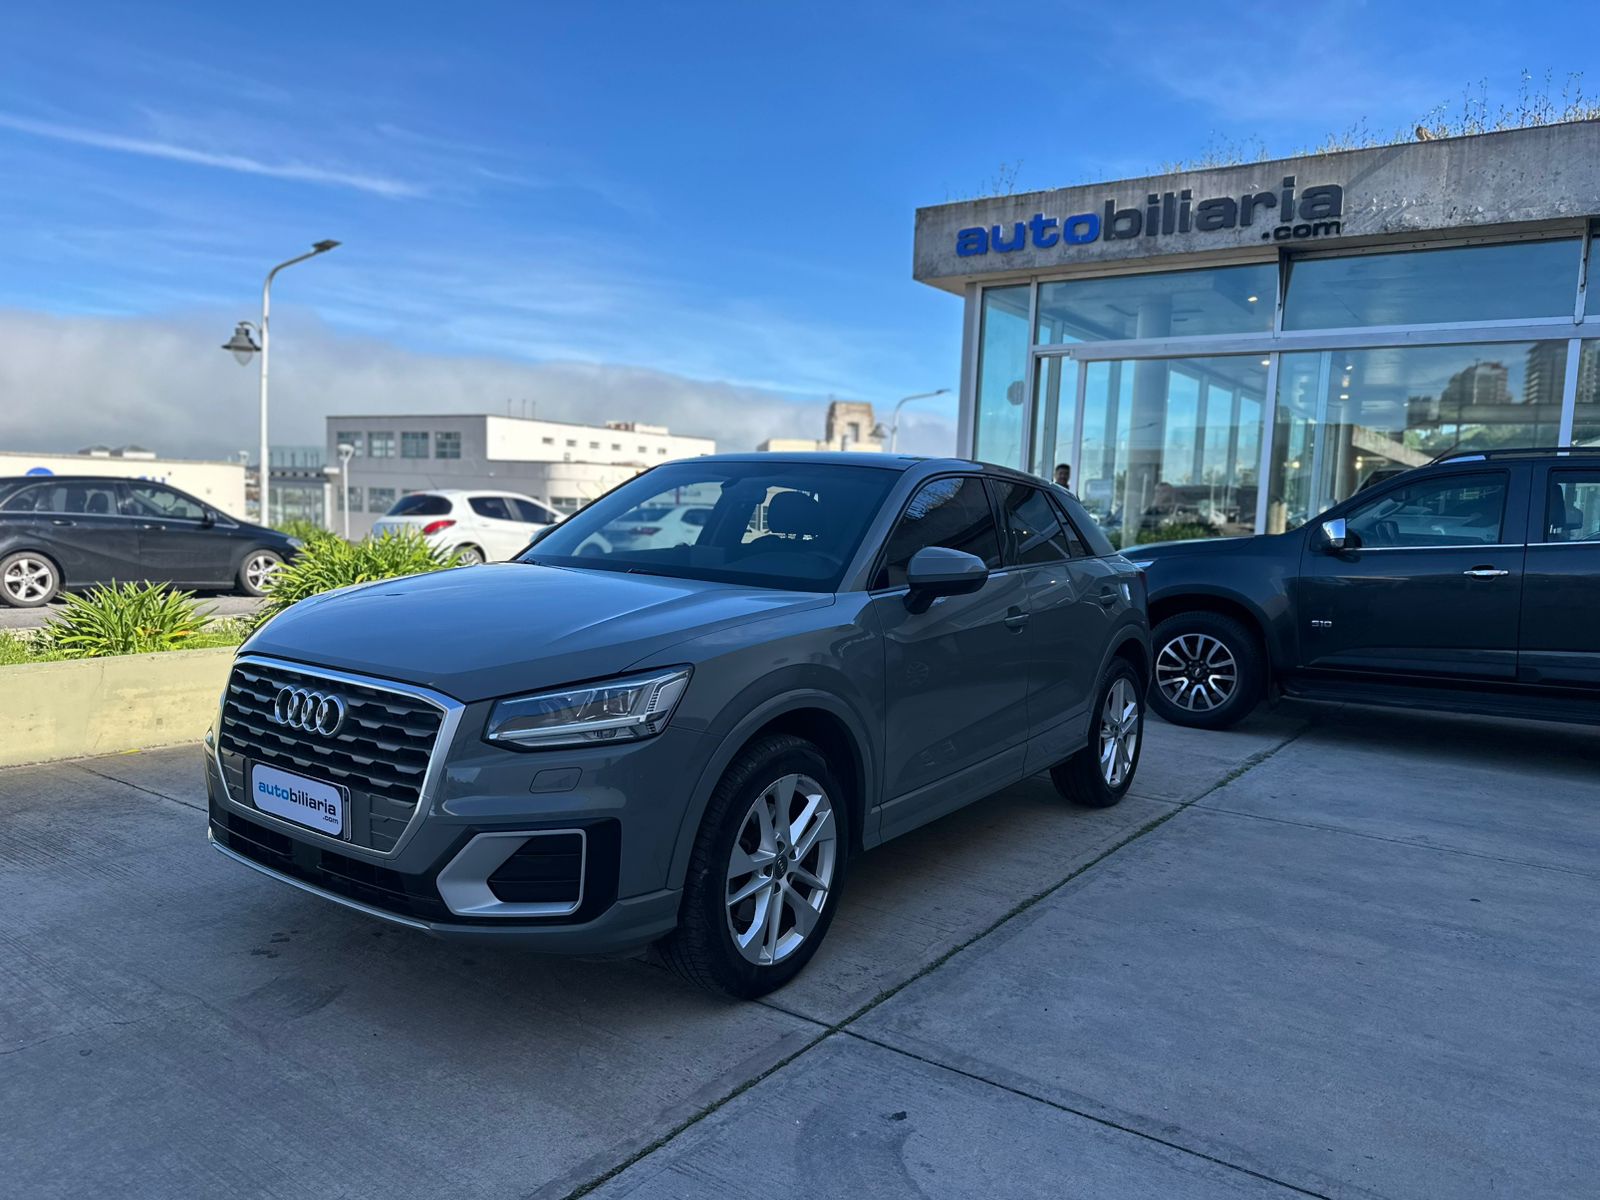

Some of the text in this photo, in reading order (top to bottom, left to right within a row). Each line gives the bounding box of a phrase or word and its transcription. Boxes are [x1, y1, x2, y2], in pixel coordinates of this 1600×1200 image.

[955, 175, 1344, 257] autobiliaria
[1262, 220, 1341, 241] .com
[258, 781, 337, 816] autobiliaria
[322, 815, 339, 825] .com
